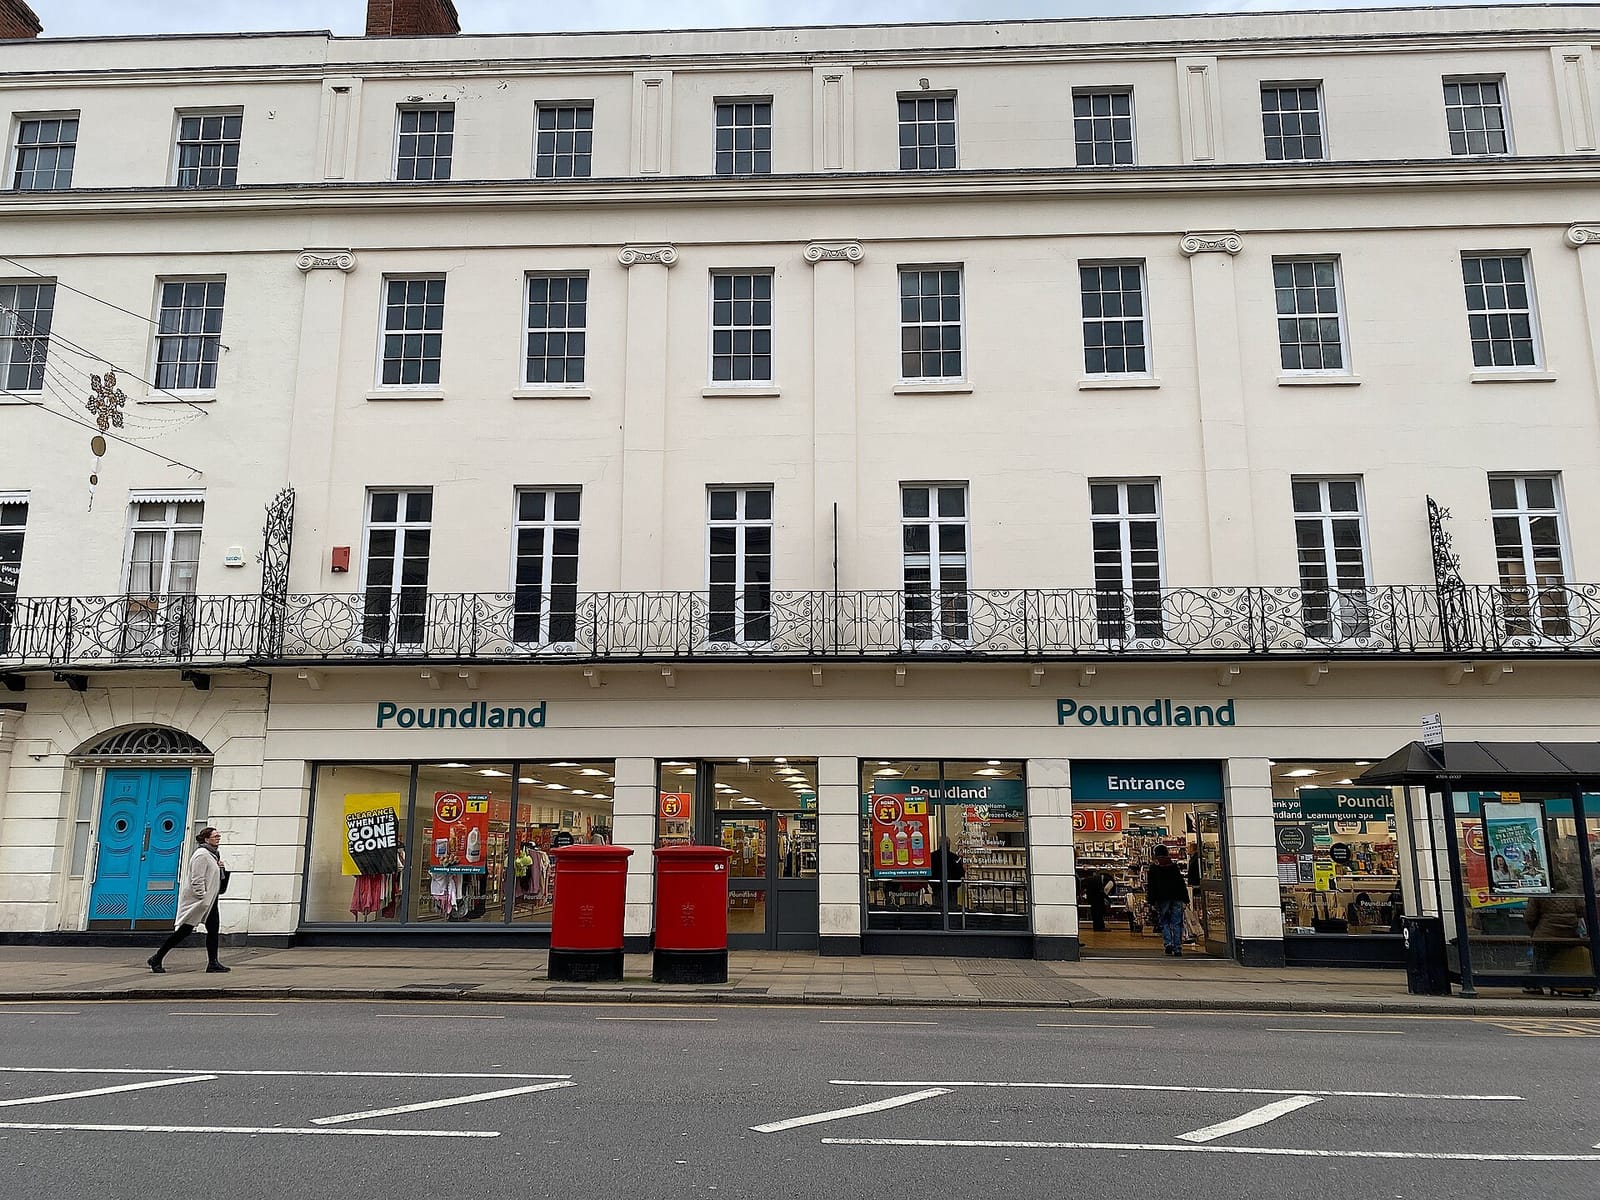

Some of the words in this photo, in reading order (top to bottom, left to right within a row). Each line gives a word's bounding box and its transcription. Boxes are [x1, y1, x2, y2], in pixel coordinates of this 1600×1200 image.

[377, 701, 547, 728] Poundland
[1057, 699, 1236, 726] Poundland
[1107, 776, 1185, 790] Entrance
[346, 807, 394, 821] CLEARANCE
[440, 805, 458, 817] £1
[880, 808, 896, 820] £1
[347, 817, 374, 829] WHEN
[376, 814, 394, 824] IT'S
[348, 821, 396, 841] GONE
[353, 835, 397, 853] GONE
